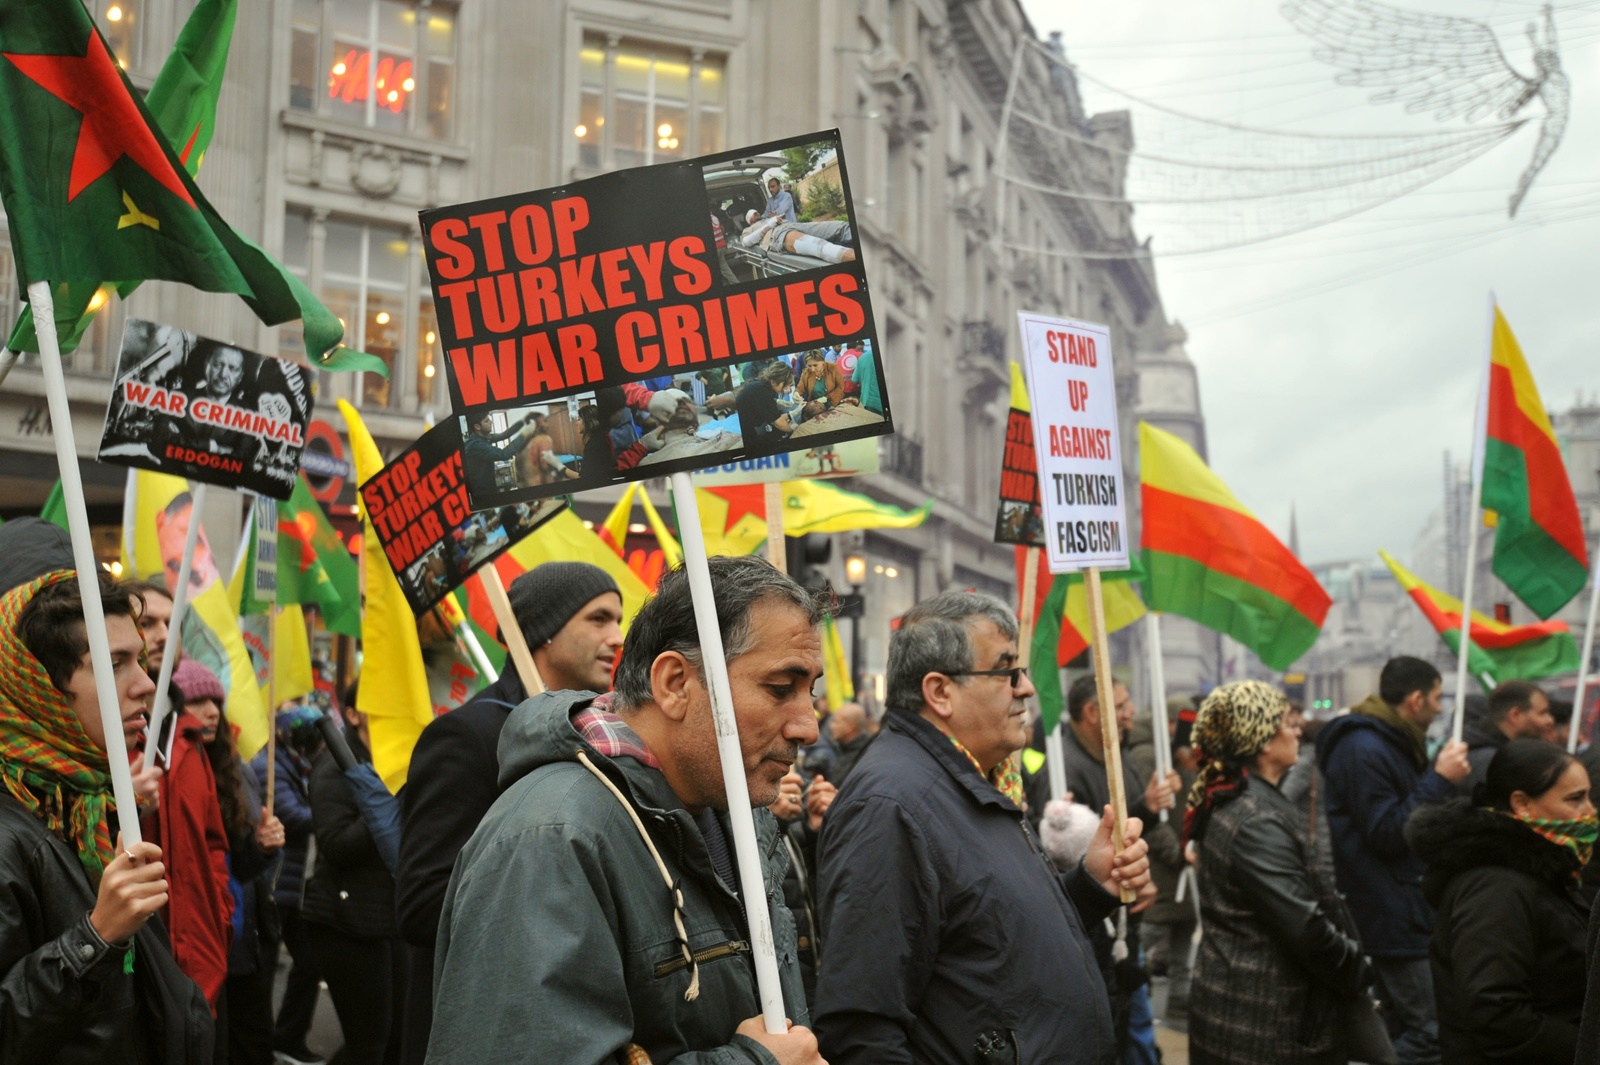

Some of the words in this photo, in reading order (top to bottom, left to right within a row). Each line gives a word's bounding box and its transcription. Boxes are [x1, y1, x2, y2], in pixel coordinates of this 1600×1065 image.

[430, 196, 590, 280] STOP
[438, 236, 712, 340] TURKEYS
[449, 324, 604, 407] WAR
[614, 273, 865, 374] CRIMES
[1046, 330, 1097, 368] STAND
[126, 382, 186, 414] WAR
[192, 400, 302, 444] CRIMINAL
[1067, 379, 1088, 412] UP
[1007, 412, 1034, 446] STO
[1049, 424, 1112, 460] AGAINST
[165, 444, 243, 474] ERDOGAN
[364, 450, 421, 516] STOP
[1052, 473, 1117, 506] TURKISH
[258, 497, 277, 534] STO
[385, 510, 445, 573] WAR
[1057, 521, 1121, 554] FASCISM
